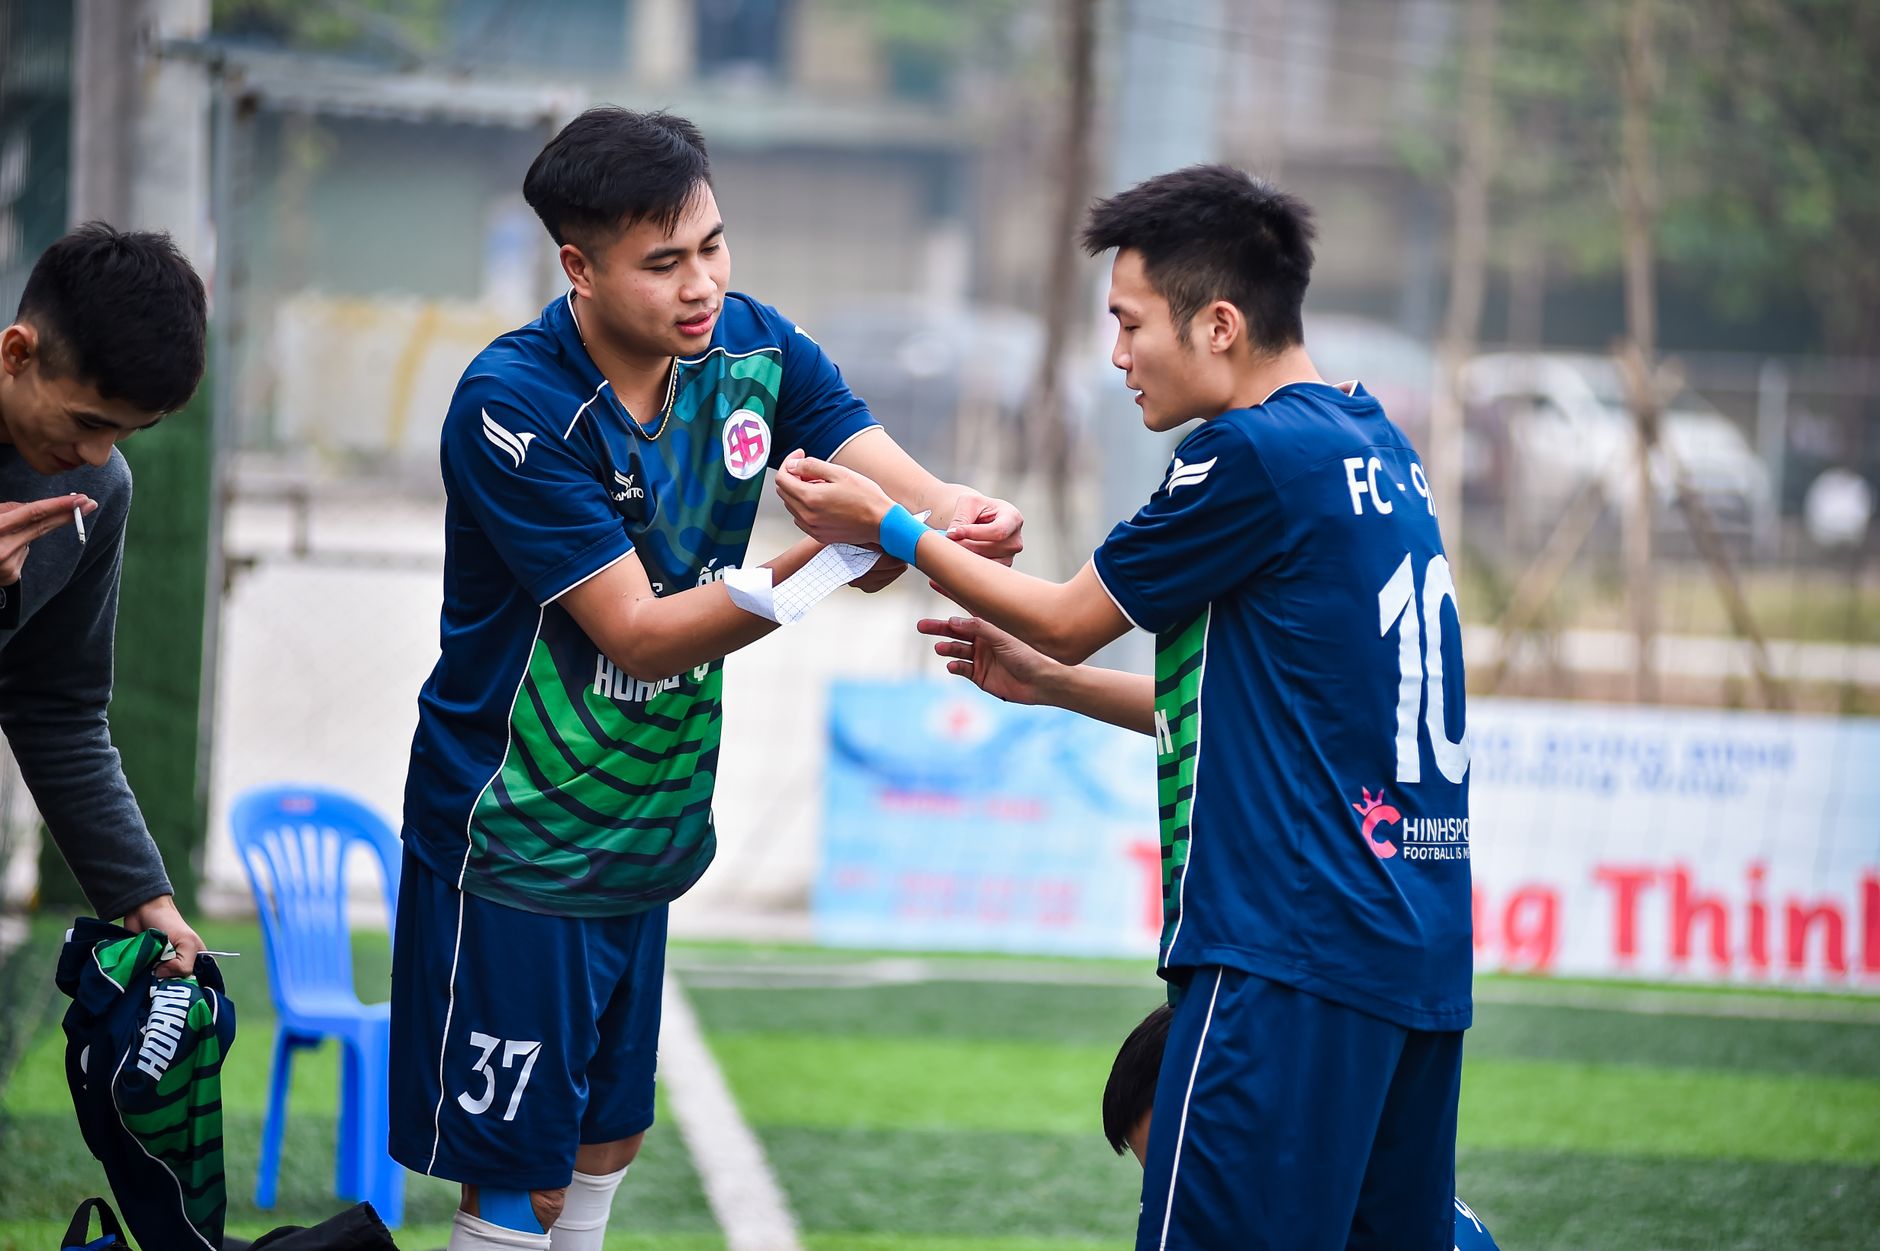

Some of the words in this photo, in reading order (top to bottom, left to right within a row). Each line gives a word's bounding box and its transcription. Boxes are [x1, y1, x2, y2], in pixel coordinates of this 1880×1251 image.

[1343, 456, 1393, 515] FC
[1409, 462, 1437, 518] 9
[1378, 552, 1471, 784] 10
[1404, 846, 1454, 860] FOOTBALL
[1456, 847, 1462, 860] IS
[457, 1031, 543, 1122] 37
